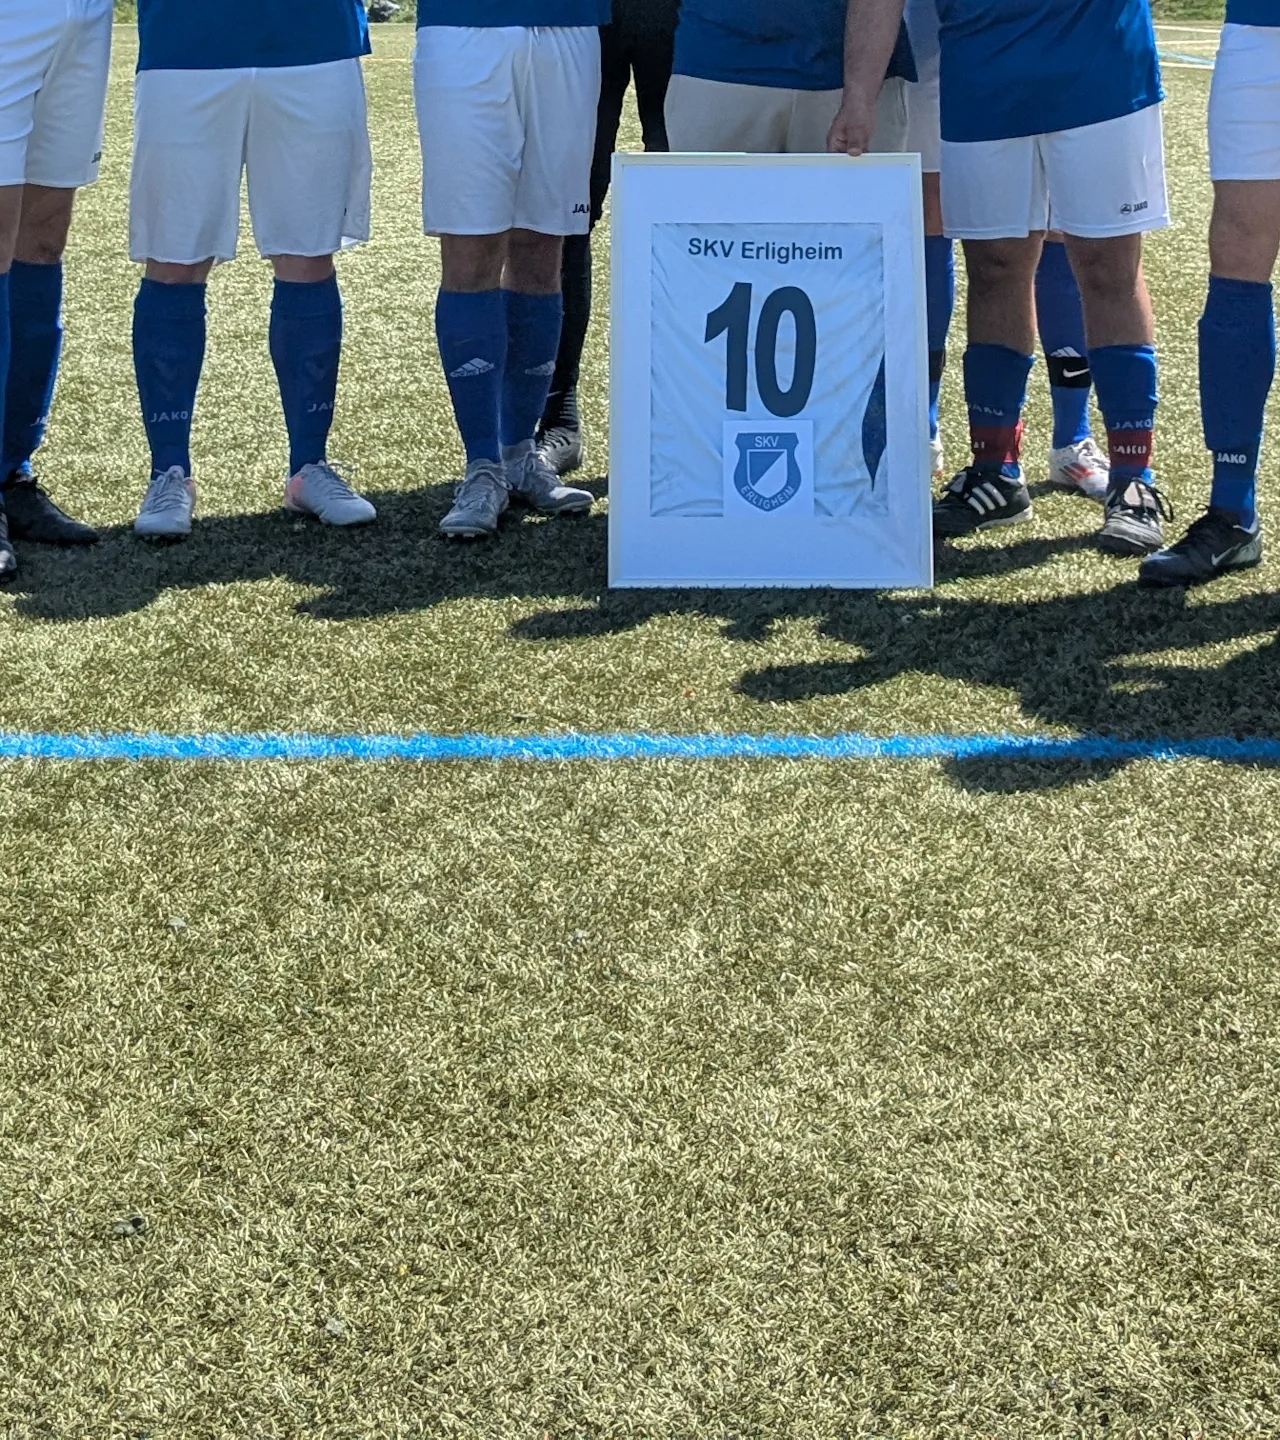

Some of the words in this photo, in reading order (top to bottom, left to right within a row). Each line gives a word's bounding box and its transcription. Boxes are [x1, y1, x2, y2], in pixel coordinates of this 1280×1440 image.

[688, 237, 735, 259] SKV
[741, 241, 844, 265] Erligheim
[704, 281, 817, 418] 10
[150, 410, 189, 422] JAKO
[1112, 418, 1152, 430] JAKO
[754, 435, 780, 448] SKV
[1216, 453, 1247, 464] JAKO
[741, 485, 795, 510] ERLIGHEIM
